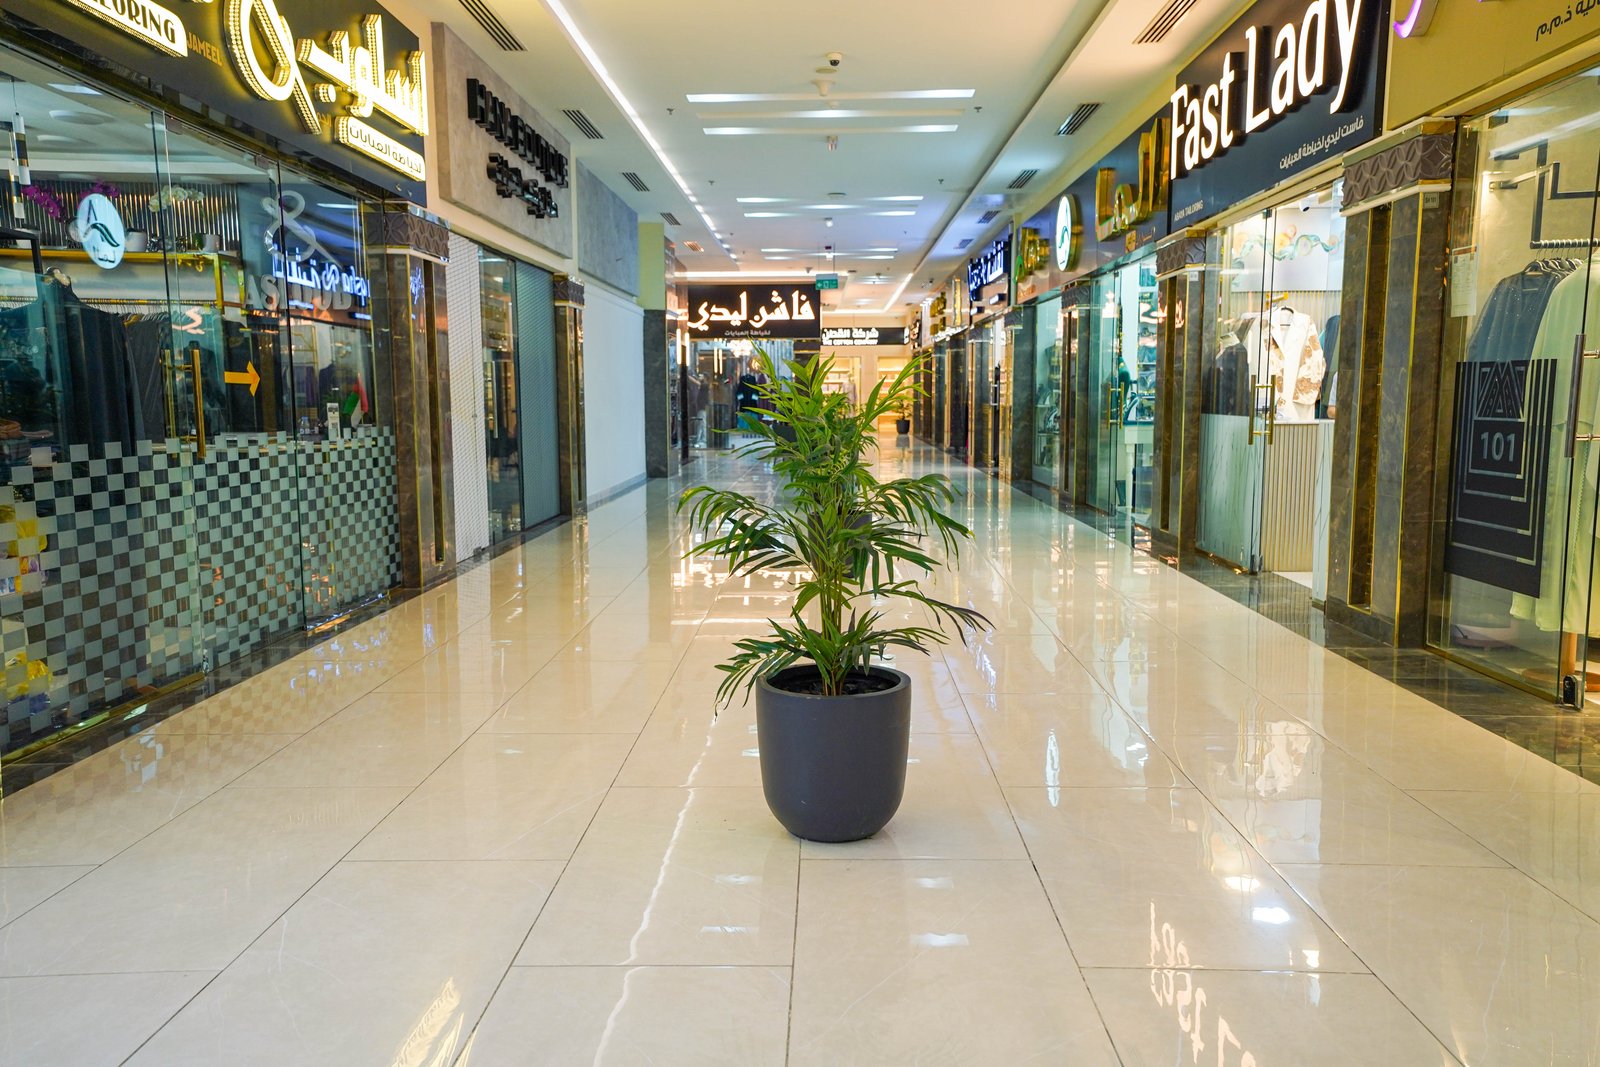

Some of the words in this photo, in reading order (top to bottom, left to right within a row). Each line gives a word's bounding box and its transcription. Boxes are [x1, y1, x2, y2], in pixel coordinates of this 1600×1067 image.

[187, 32, 223, 66] JAMEEL
[1170, 52, 1234, 180] Fast
[1245, 0, 1362, 133] Lady
[1341, 115, 1364, 137] فاست
[687, 291, 747, 331] ليدي
[749, 290, 815, 328] فاشن
[1481, 431, 1516, 462] 101
